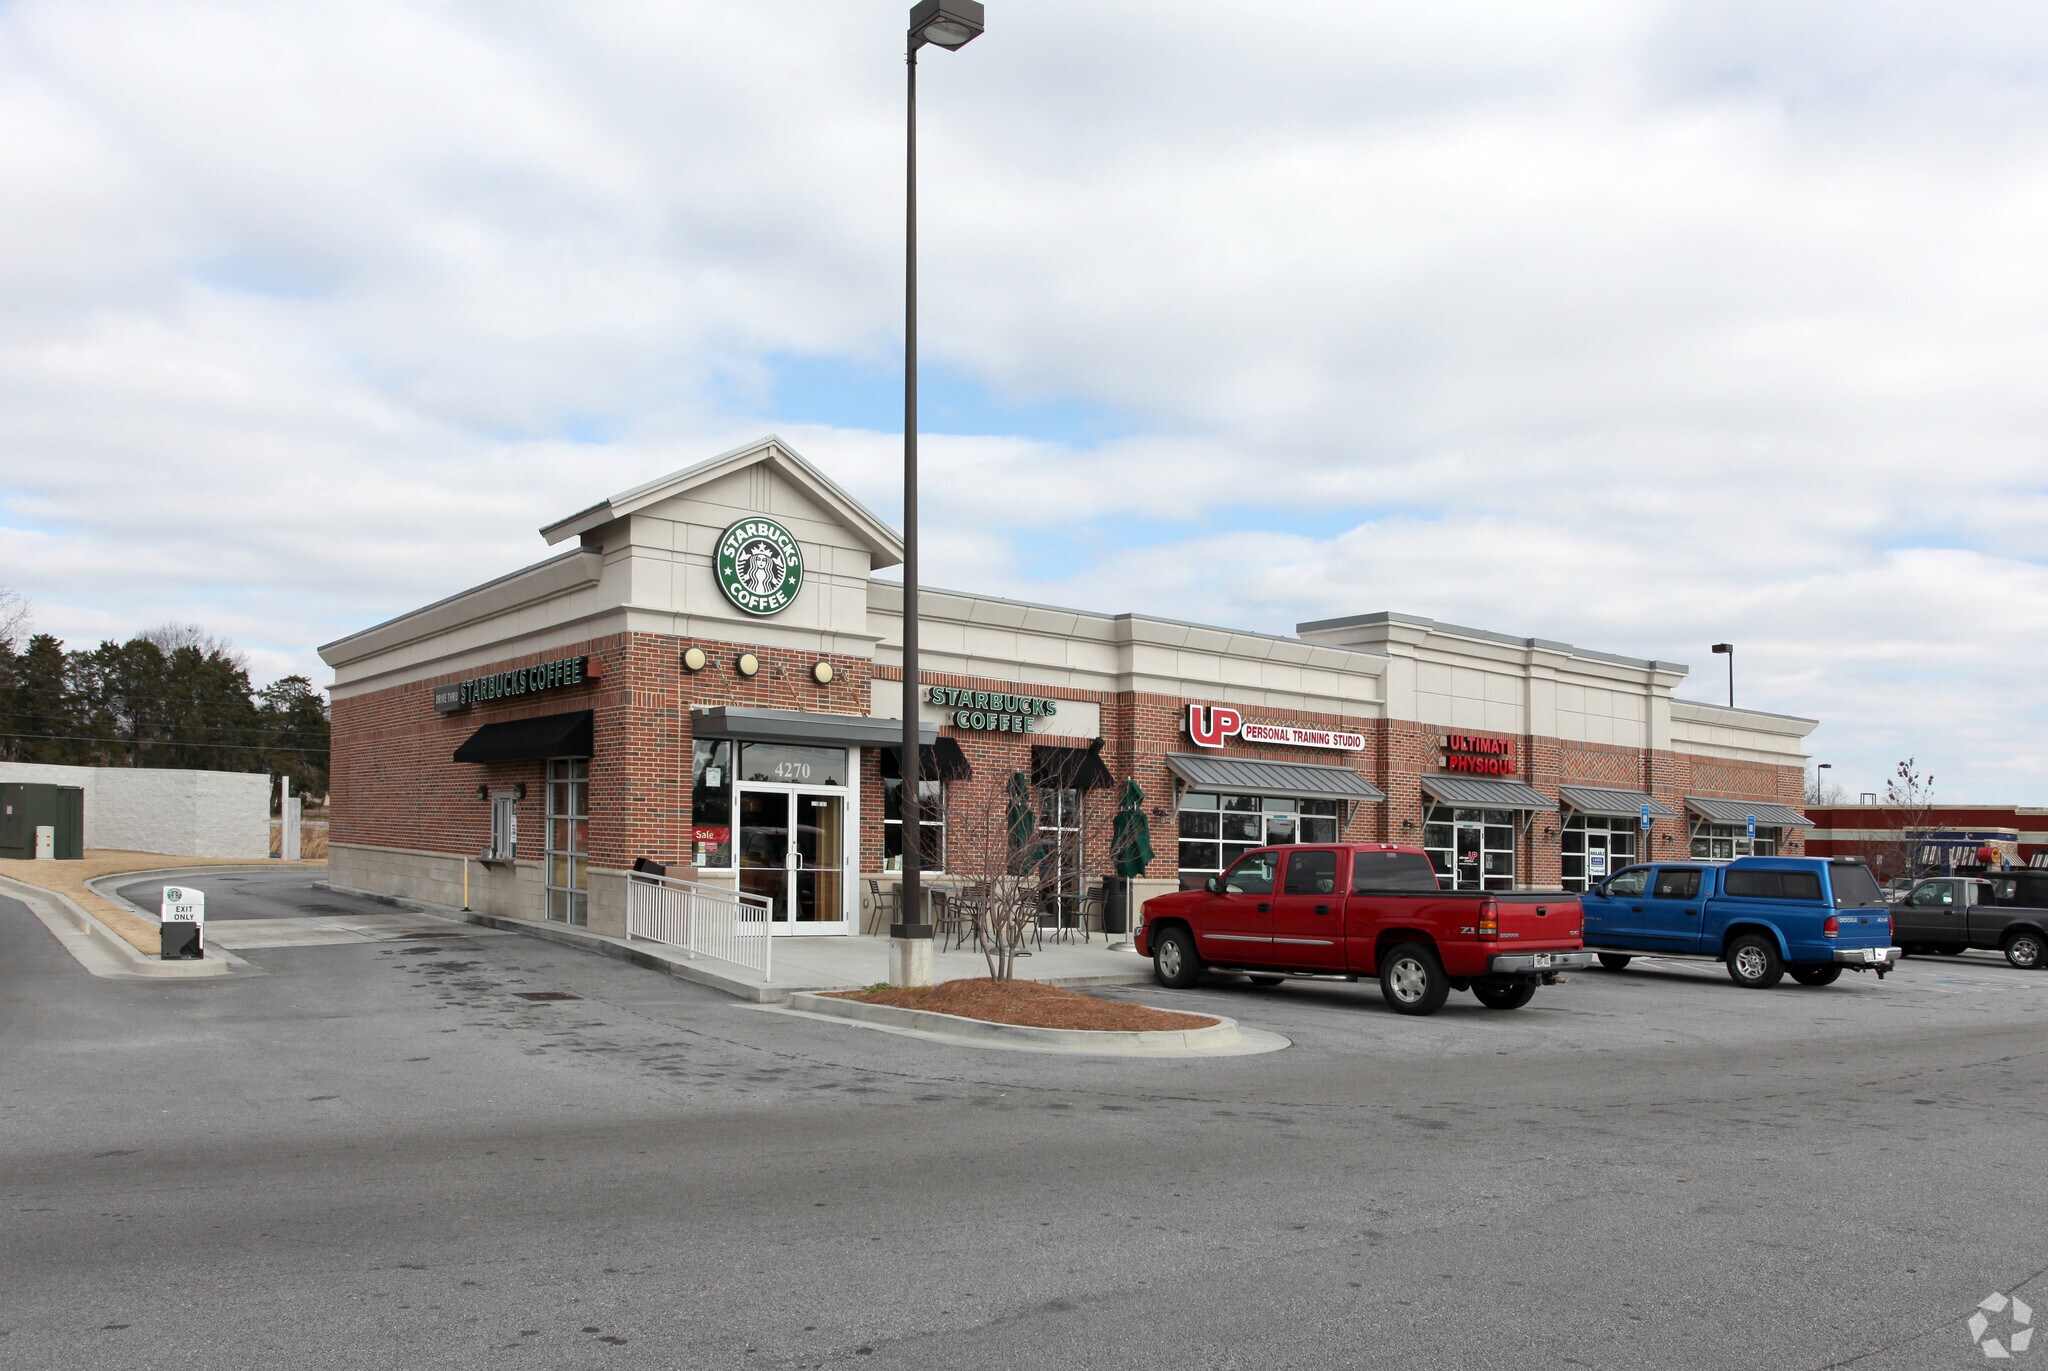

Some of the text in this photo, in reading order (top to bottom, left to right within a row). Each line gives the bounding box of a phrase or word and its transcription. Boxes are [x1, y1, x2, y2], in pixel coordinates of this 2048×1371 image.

[723, 522, 799, 567] STARBUCKS
[730, 583, 788, 610] COFFEE
[460, 668, 527, 704] STARBUCKS
[529, 656, 582, 692] COFFEE
[932, 687, 1057, 716] STARBUCKS
[956, 710, 1035, 733] COFFEE
[1189, 703, 1361, 749] UP PERSONAL TRAINING STUDIO
[1450, 735, 1517, 755] ULTIMATE
[774, 762, 811, 779] 4270
[1449, 755, 1517, 775] PHYSIQUE
[696, 830, 714, 839] Sale
